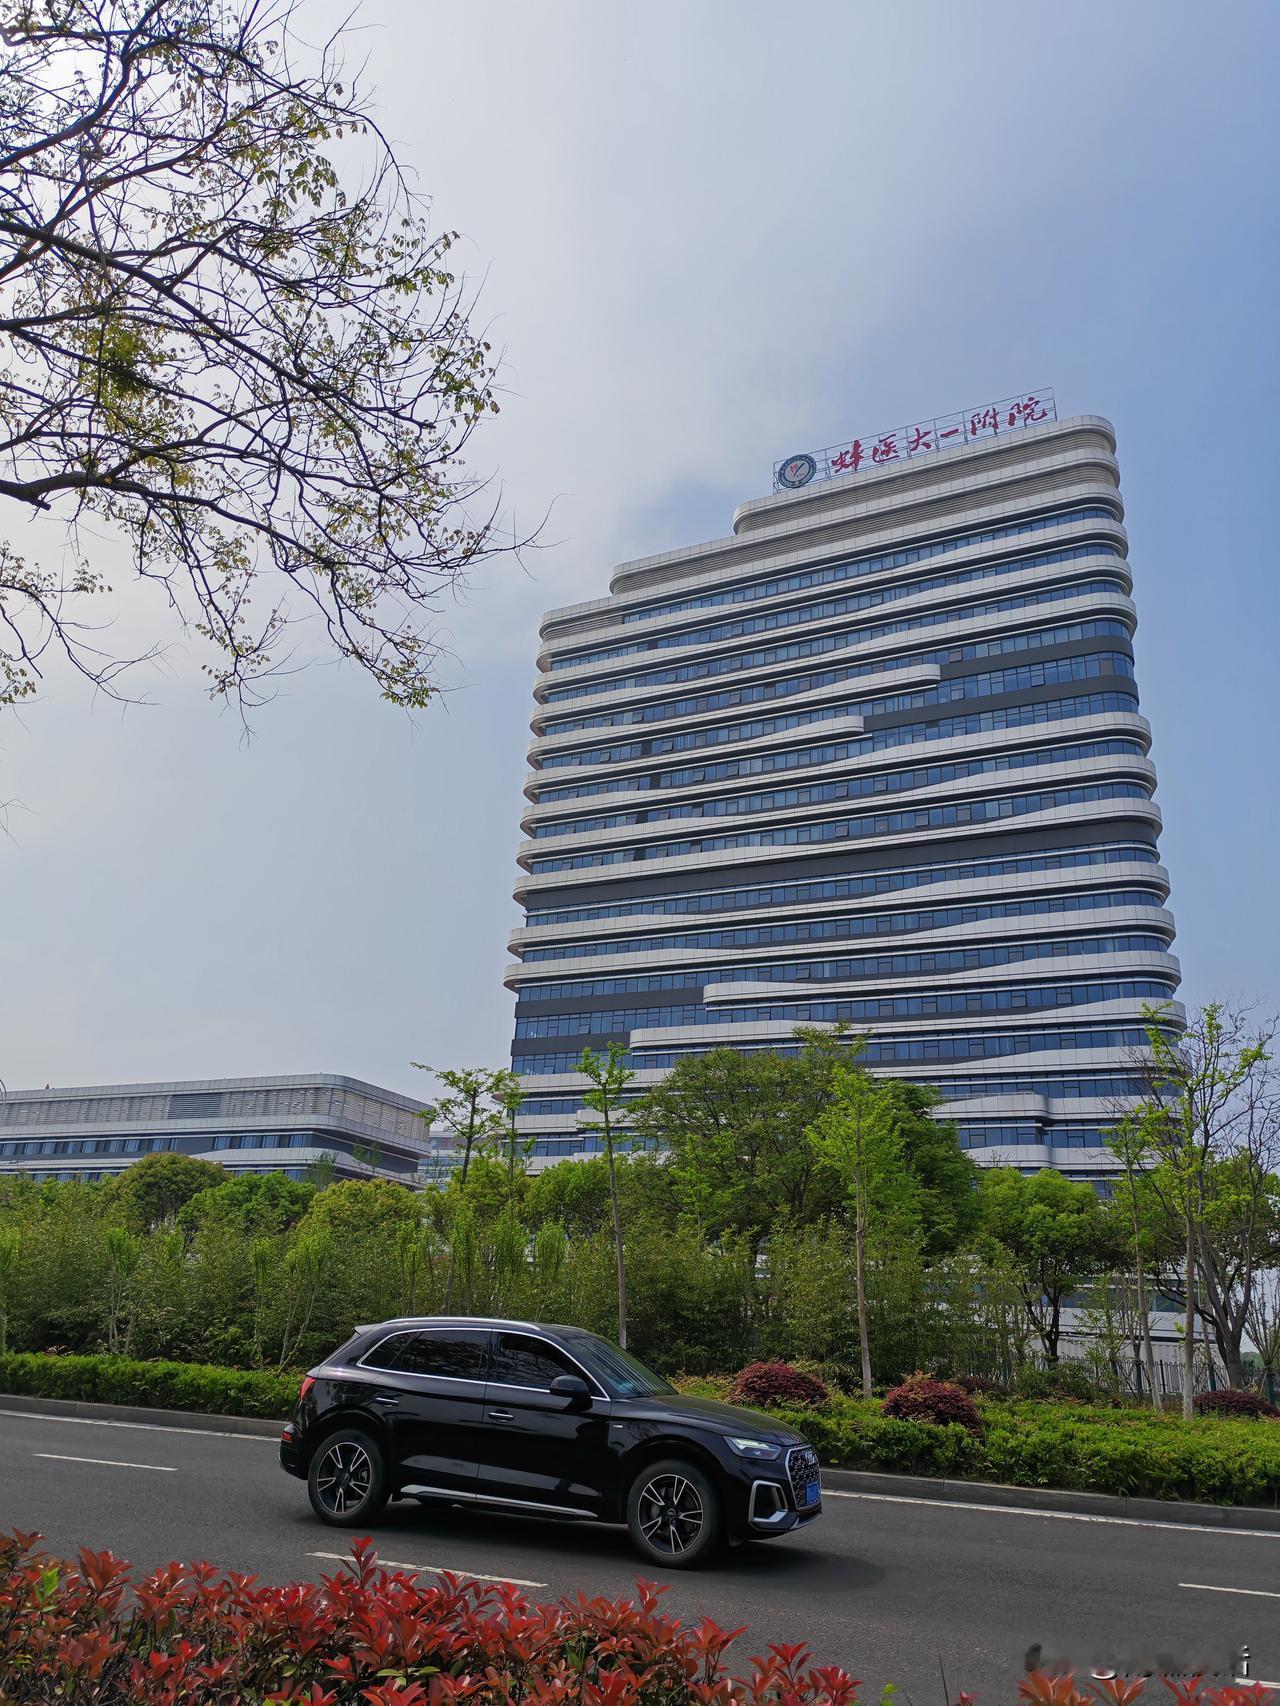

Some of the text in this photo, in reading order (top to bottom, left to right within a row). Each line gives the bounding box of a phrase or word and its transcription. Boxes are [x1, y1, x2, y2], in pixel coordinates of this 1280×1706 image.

[831, 397, 1048, 473] 蚌医大一附院
